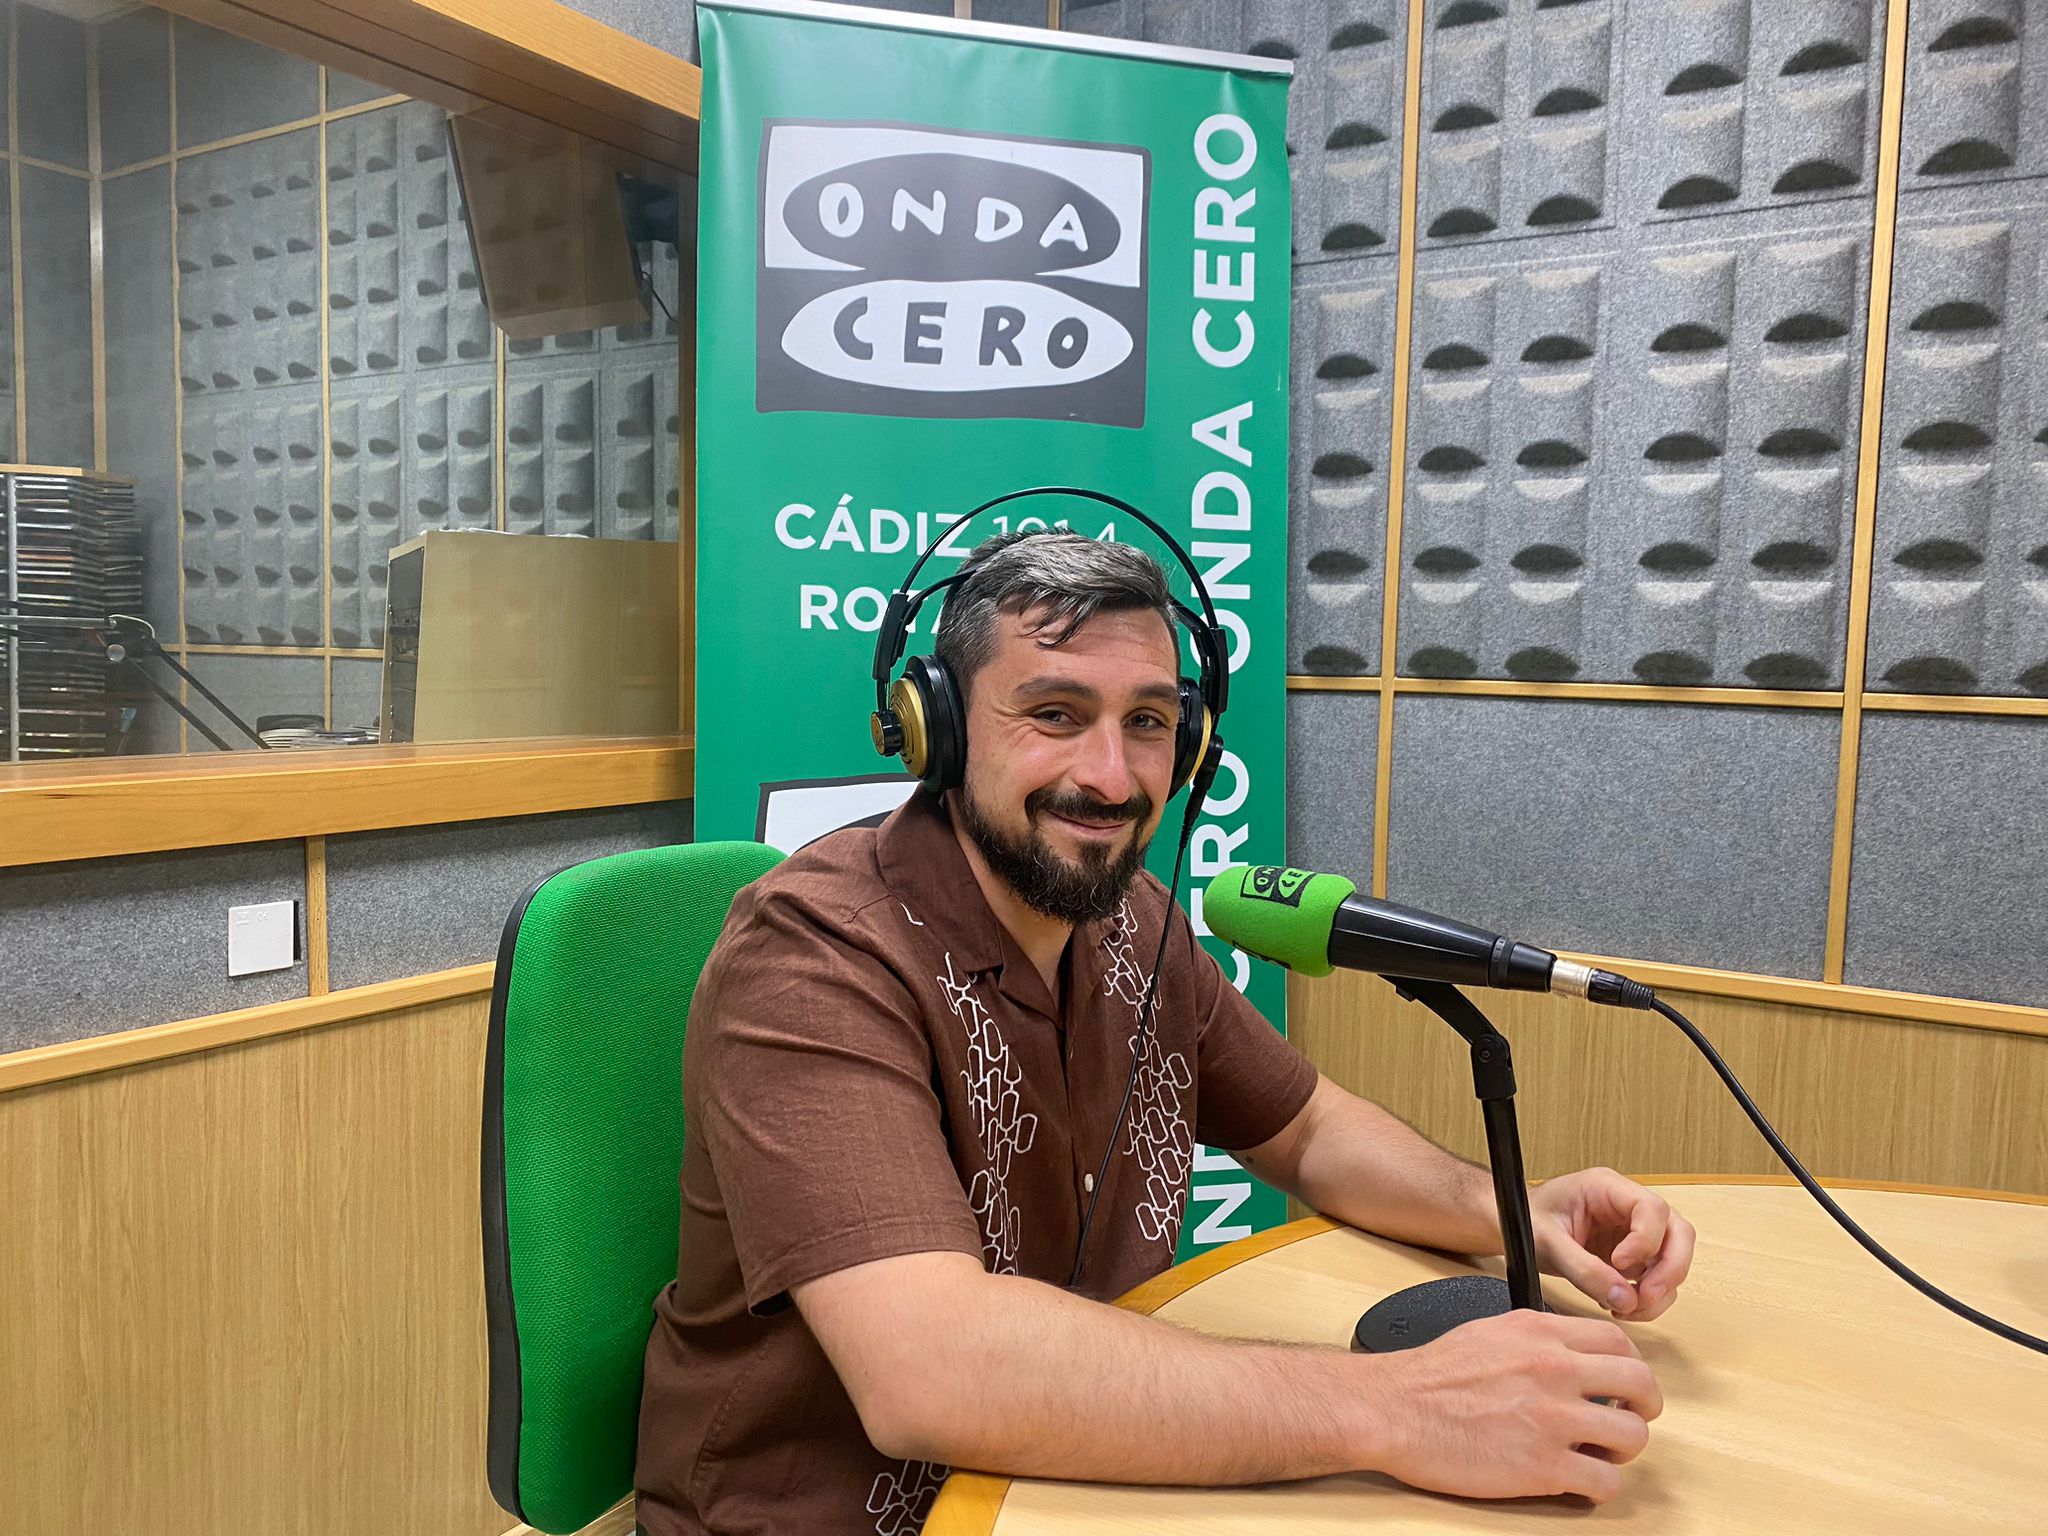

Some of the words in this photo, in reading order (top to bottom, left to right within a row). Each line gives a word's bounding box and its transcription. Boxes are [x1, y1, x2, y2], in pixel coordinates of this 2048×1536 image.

[818, 181, 1089, 253] ONDA
[1192, 113, 1258, 369] CERO
[833, 296, 1089, 370] CERO
[775, 493, 971, 557] CÁDIZ
[1190, 400, 1253, 676] ONDA
[800, 584, 945, 634] RO
